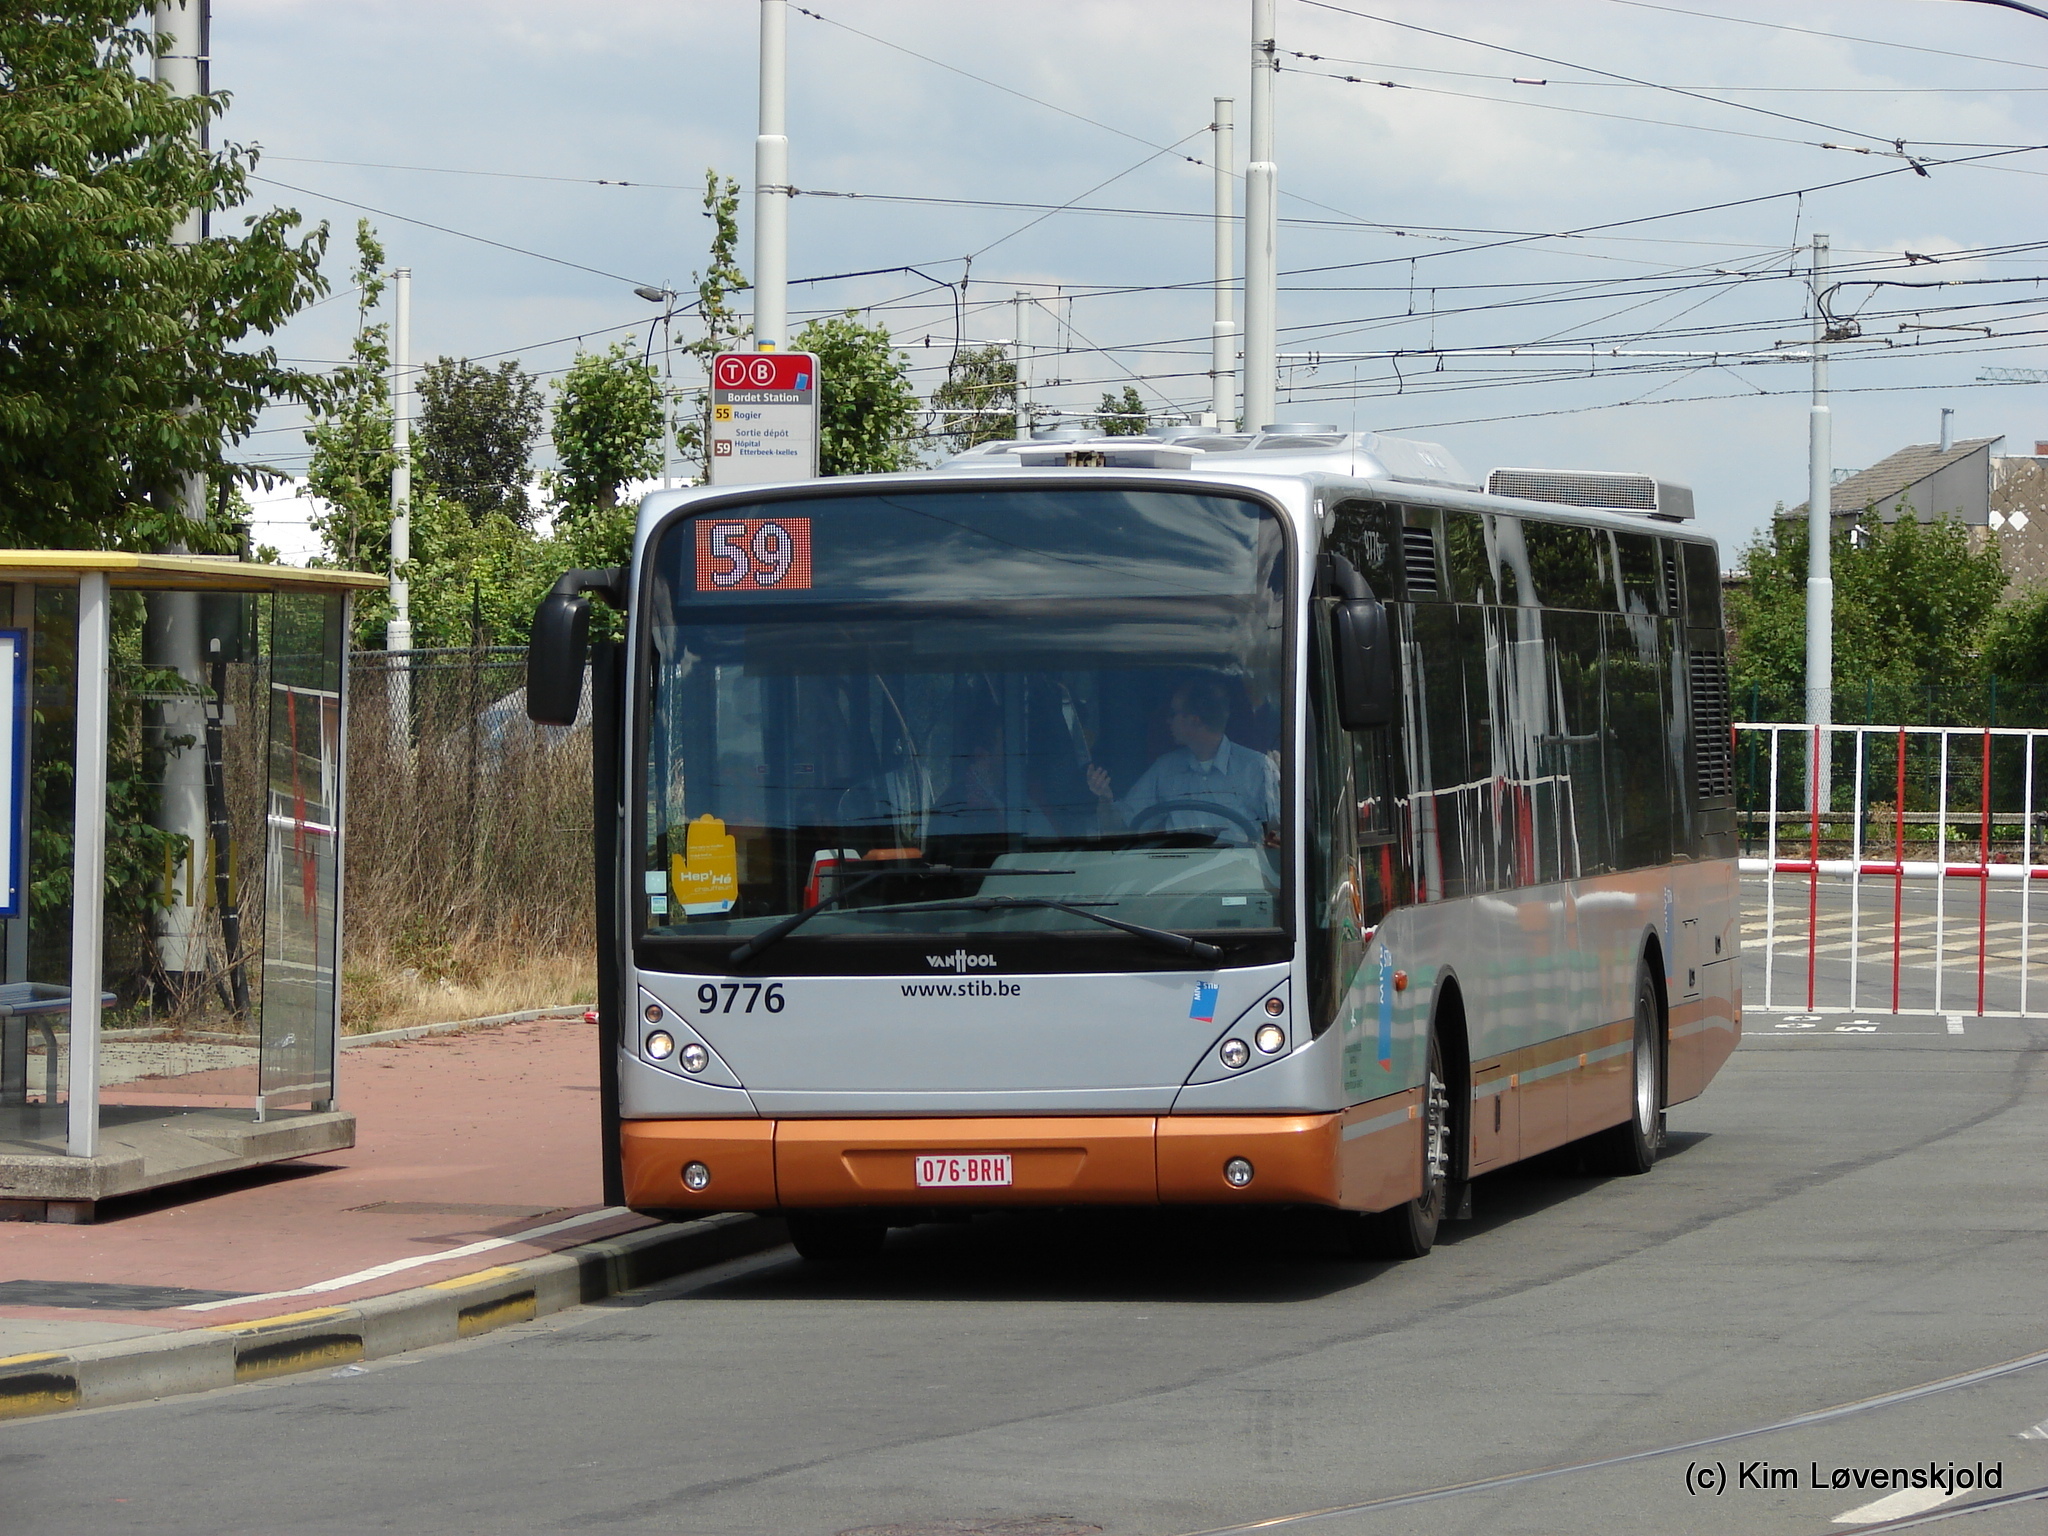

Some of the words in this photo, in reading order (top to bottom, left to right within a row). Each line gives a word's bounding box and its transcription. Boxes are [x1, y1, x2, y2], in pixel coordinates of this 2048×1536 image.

[726, 364, 739, 380] T
[757, 364, 769, 380] B
[727, 393, 762, 402] Bordet
[763, 393, 799, 402] Station
[716, 408, 730, 419] 55
[734, 411, 762, 421] Rogier
[735, 428, 761, 437] Sortie
[763, 428, 789, 438] dépôt
[716, 443, 731, 454] 59
[735, 440, 761, 448] Hôpital
[739, 448, 798, 456] Etterbeek-Ixelles
[711, 521, 793, 588] 59
[712, 873, 733, 885] Hé
[901, 980, 1021, 997] www.stib.be
[697, 983, 785, 1014] 9776
